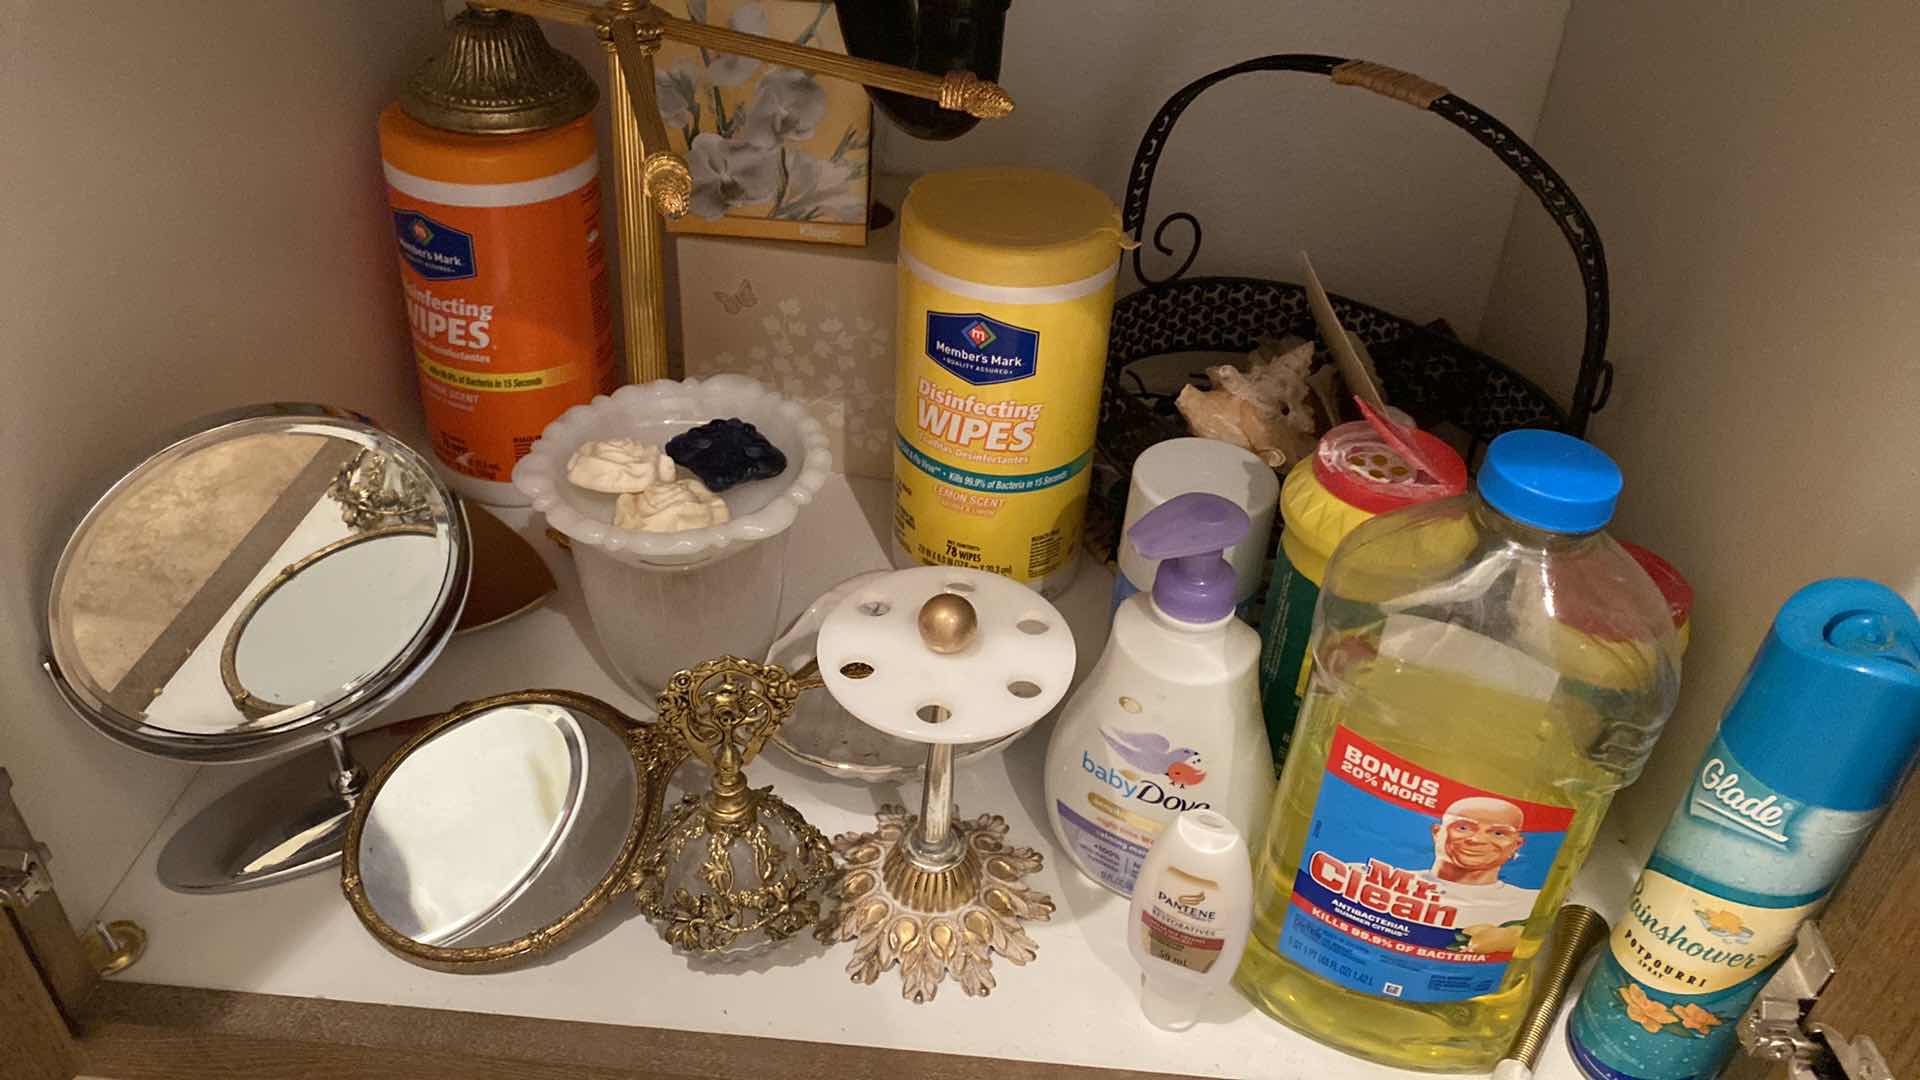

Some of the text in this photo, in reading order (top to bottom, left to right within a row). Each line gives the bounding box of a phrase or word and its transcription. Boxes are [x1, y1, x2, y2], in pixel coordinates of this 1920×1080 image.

[434, 251, 462, 266] Mark
[404, 279, 494, 322] sinfecting
[935, 340, 1023, 367] Member's Mark
[946, 357, 1009, 376] QUALITY ASSURED
[918, 377, 1043, 421] Disinfecting
[917, 397, 1037, 453] WIPES
[934, 484, 1004, 508] LEMON SCENT
[996, 480, 1025, 490] Bacteria
[946, 544, 981, 562] 78 WIPES
[1341, 760, 1438, 809] 20% MORE
[1344, 743, 1440, 797] BONUS
[1701, 758, 1784, 828] Glade
[1158, 890, 1217, 920] PANTENE
[1309, 849, 1457, 930] Clean
[1152, 908, 1217, 937] RESTORATIVES
[1331, 899, 1410, 933] ANTIBACTERIAL
[1334, 907, 1370, 927] SUMMER
[1311, 906, 1349, 932] KILLS
[1351, 928, 1393, 949] 99.9%
[1395, 944, 1414, 954] OF
[1416, 947, 1487, 962] BACTERIA
[1624, 928, 1708, 989] POTPOURRI
[1636, 959, 1665, 980] SPRAY
